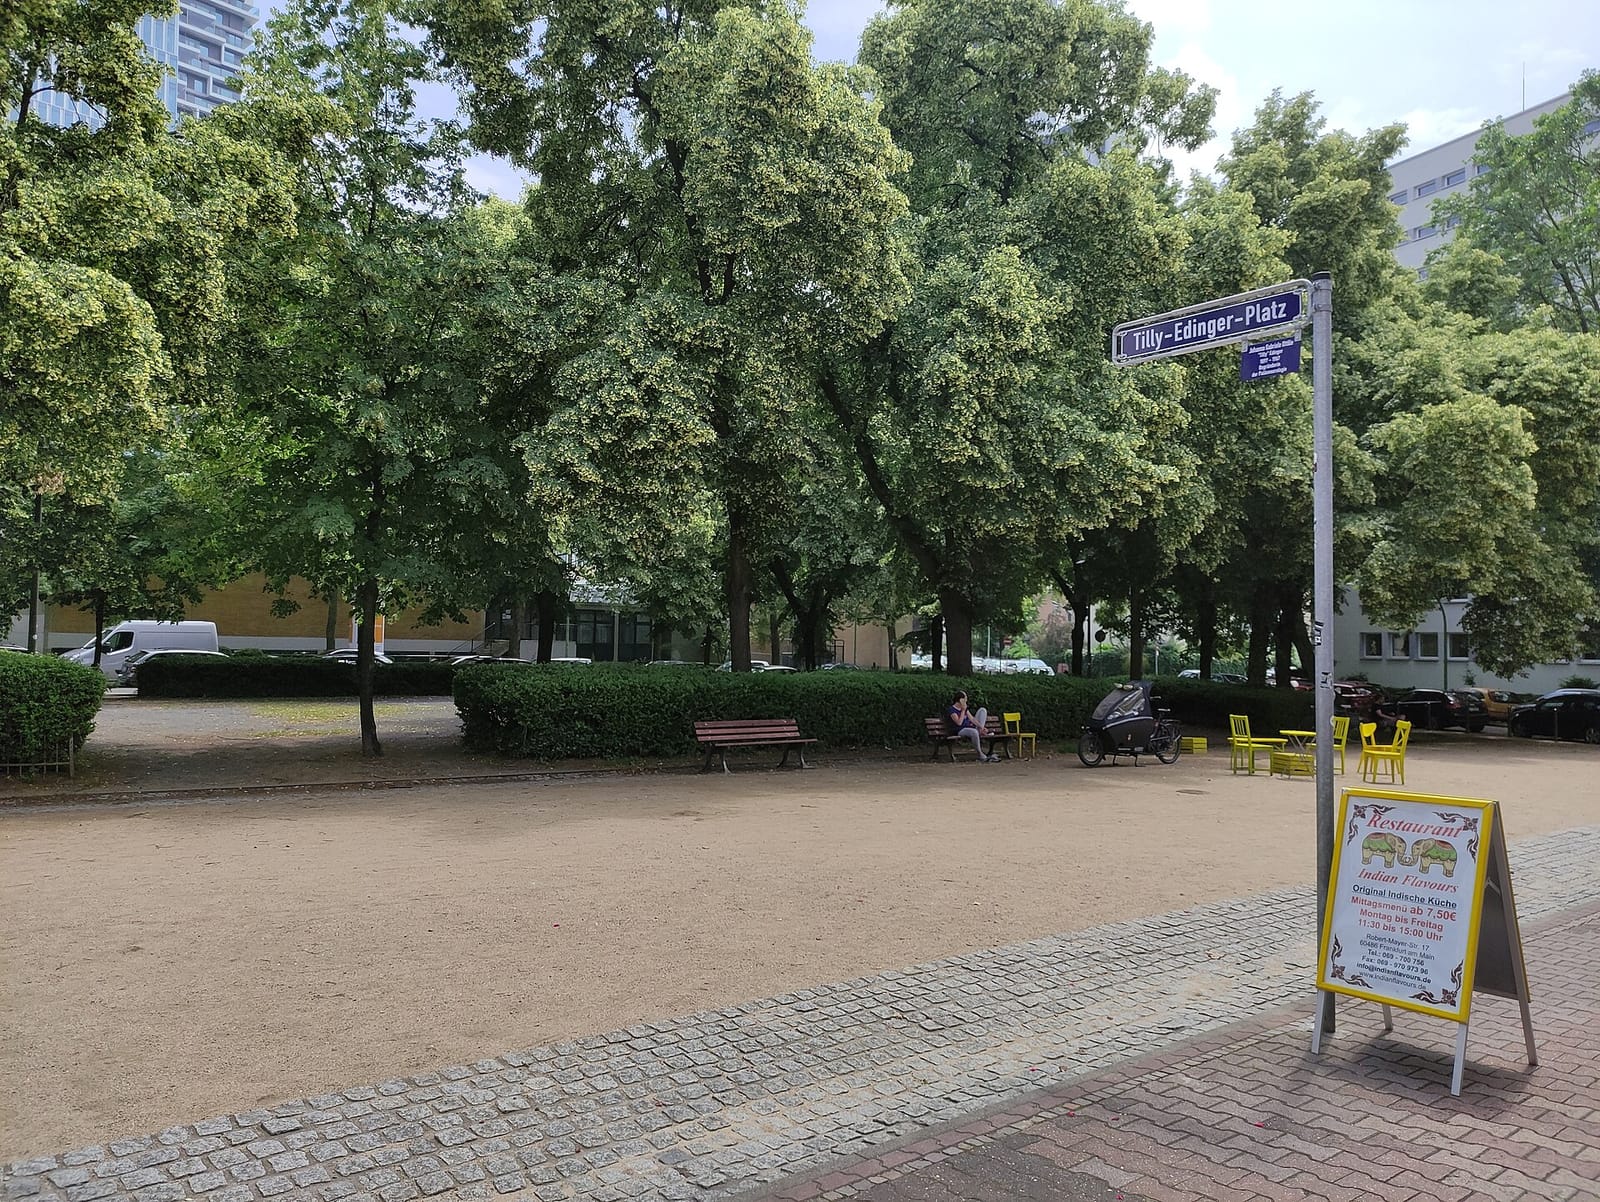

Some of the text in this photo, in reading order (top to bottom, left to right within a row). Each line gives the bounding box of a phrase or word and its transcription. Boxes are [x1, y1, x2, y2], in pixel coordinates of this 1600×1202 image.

[1133, 301, 1287, 351] Tilly-Edinger-Platz
[1366, 813, 1464, 838] Restaurant
[1357, 868, 1460, 892] Indian Flavours
[1351, 896, 1408, 913] Mittagsmenü
[1410, 906, 1424, 916] ab
[1352, 884, 1457, 909] Original Indische Küche
[1358, 918, 1444, 942] 11:30 bis 15:00 Uhr
[1359, 908, 1444, 932] Montag bis Freitag
[1366, 933, 1420, 949] Robert-Mayer-Str.
[1379, 943, 1407, 954] Frankfurt
[1419, 952, 1435, 961] Main
